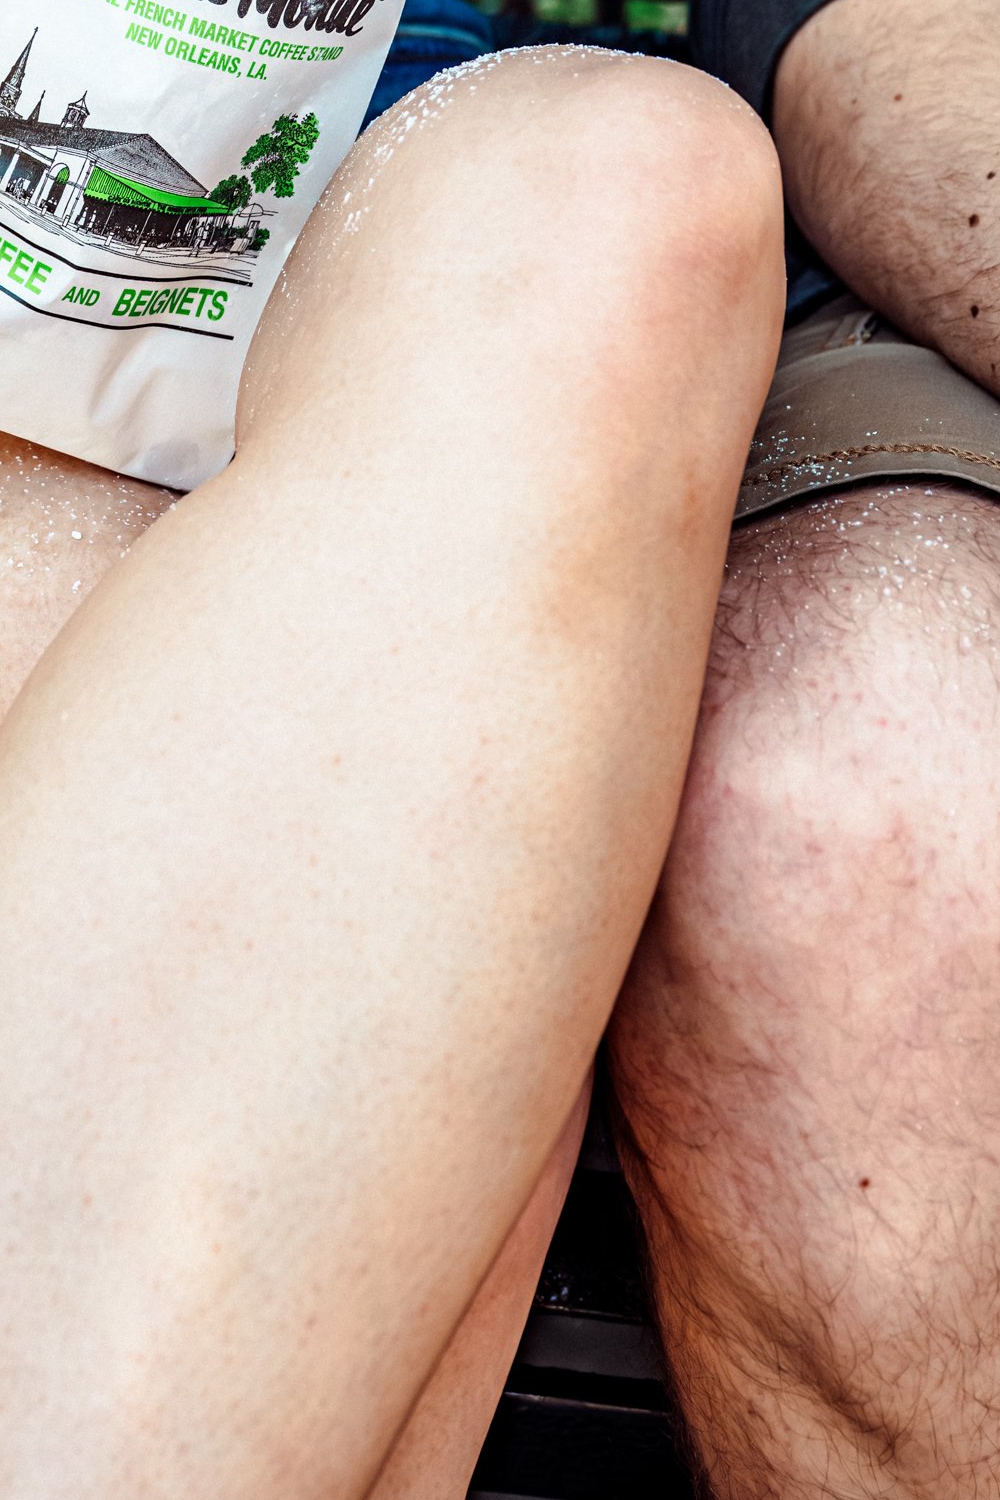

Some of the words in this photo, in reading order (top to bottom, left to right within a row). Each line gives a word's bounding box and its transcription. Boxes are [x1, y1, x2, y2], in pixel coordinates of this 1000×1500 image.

[126, 23, 163, 49] NEW
[164, 36, 242, 79] ORLEANS,
[247, 62, 266, 79] LA.
[189, 17, 258, 52] MARKET
[259, 39, 309, 60] COFFEE
[306, 44, 343, 62] STAND
[65, 287, 100, 305] AND
[113, 288, 228, 321] BEIGNETS
